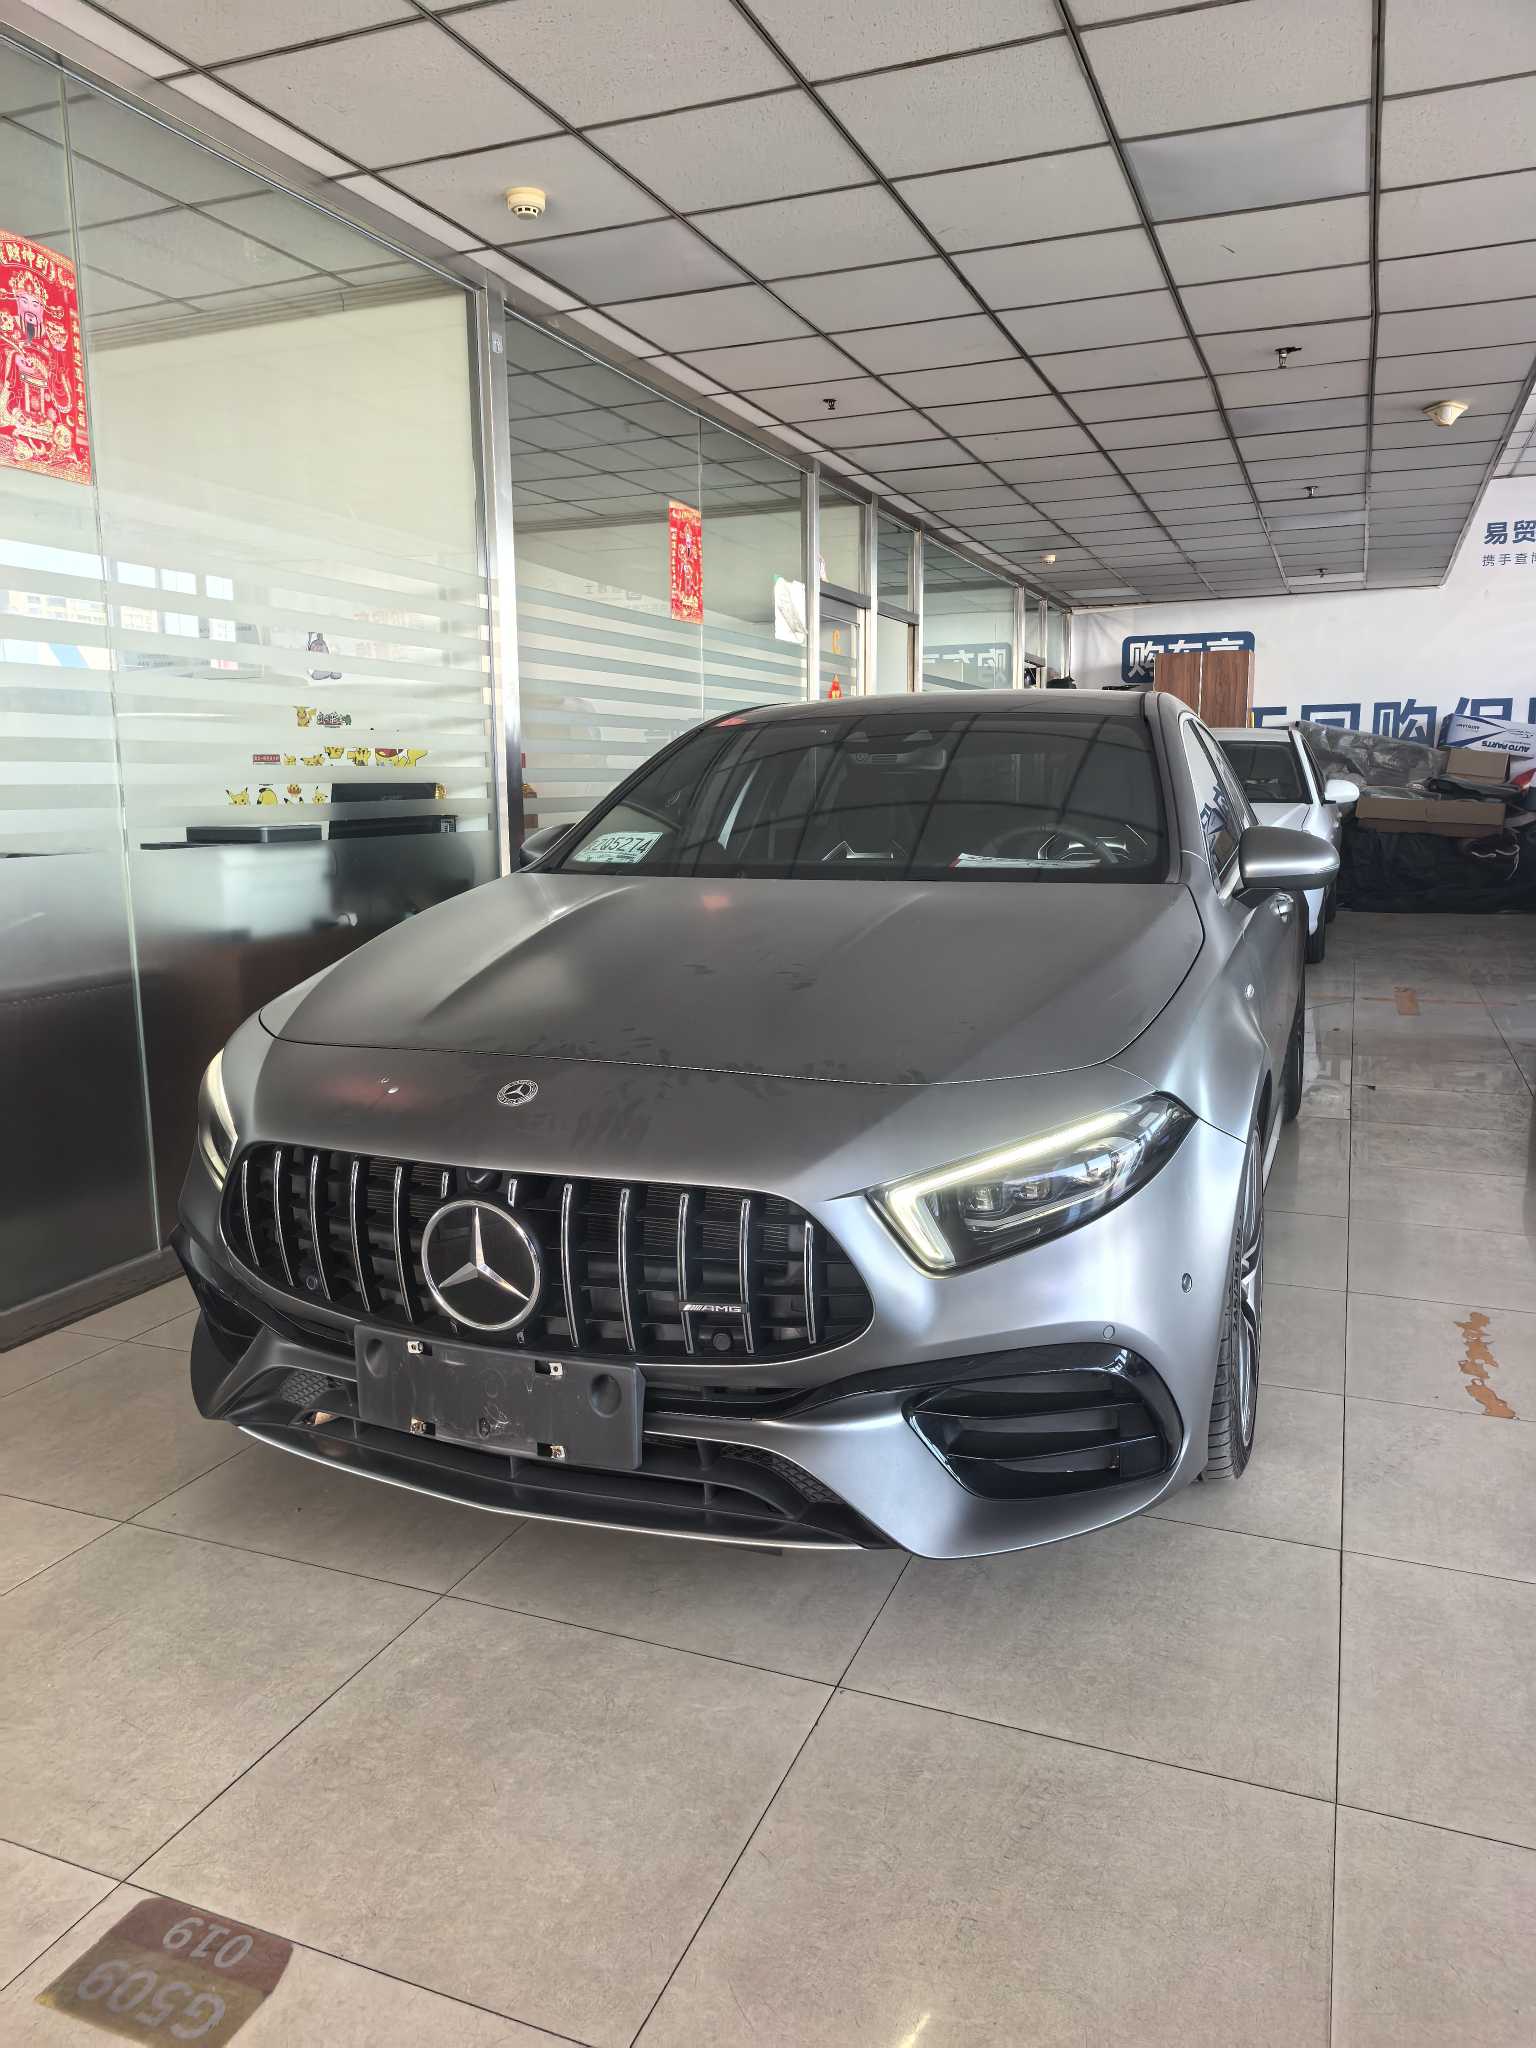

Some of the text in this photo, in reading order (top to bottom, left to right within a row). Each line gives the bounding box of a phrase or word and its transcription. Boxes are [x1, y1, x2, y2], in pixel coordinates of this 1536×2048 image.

[1484, 520, 1536, 545] 易贸
[1481, 740, 1508, 750] PARTS
[1508, 744, 1531, 753] AUTO
[701, 1304, 742, 1313] AMG
[163, 1917, 253, 1968] 019
[78, 1959, 225, 2039] G509
